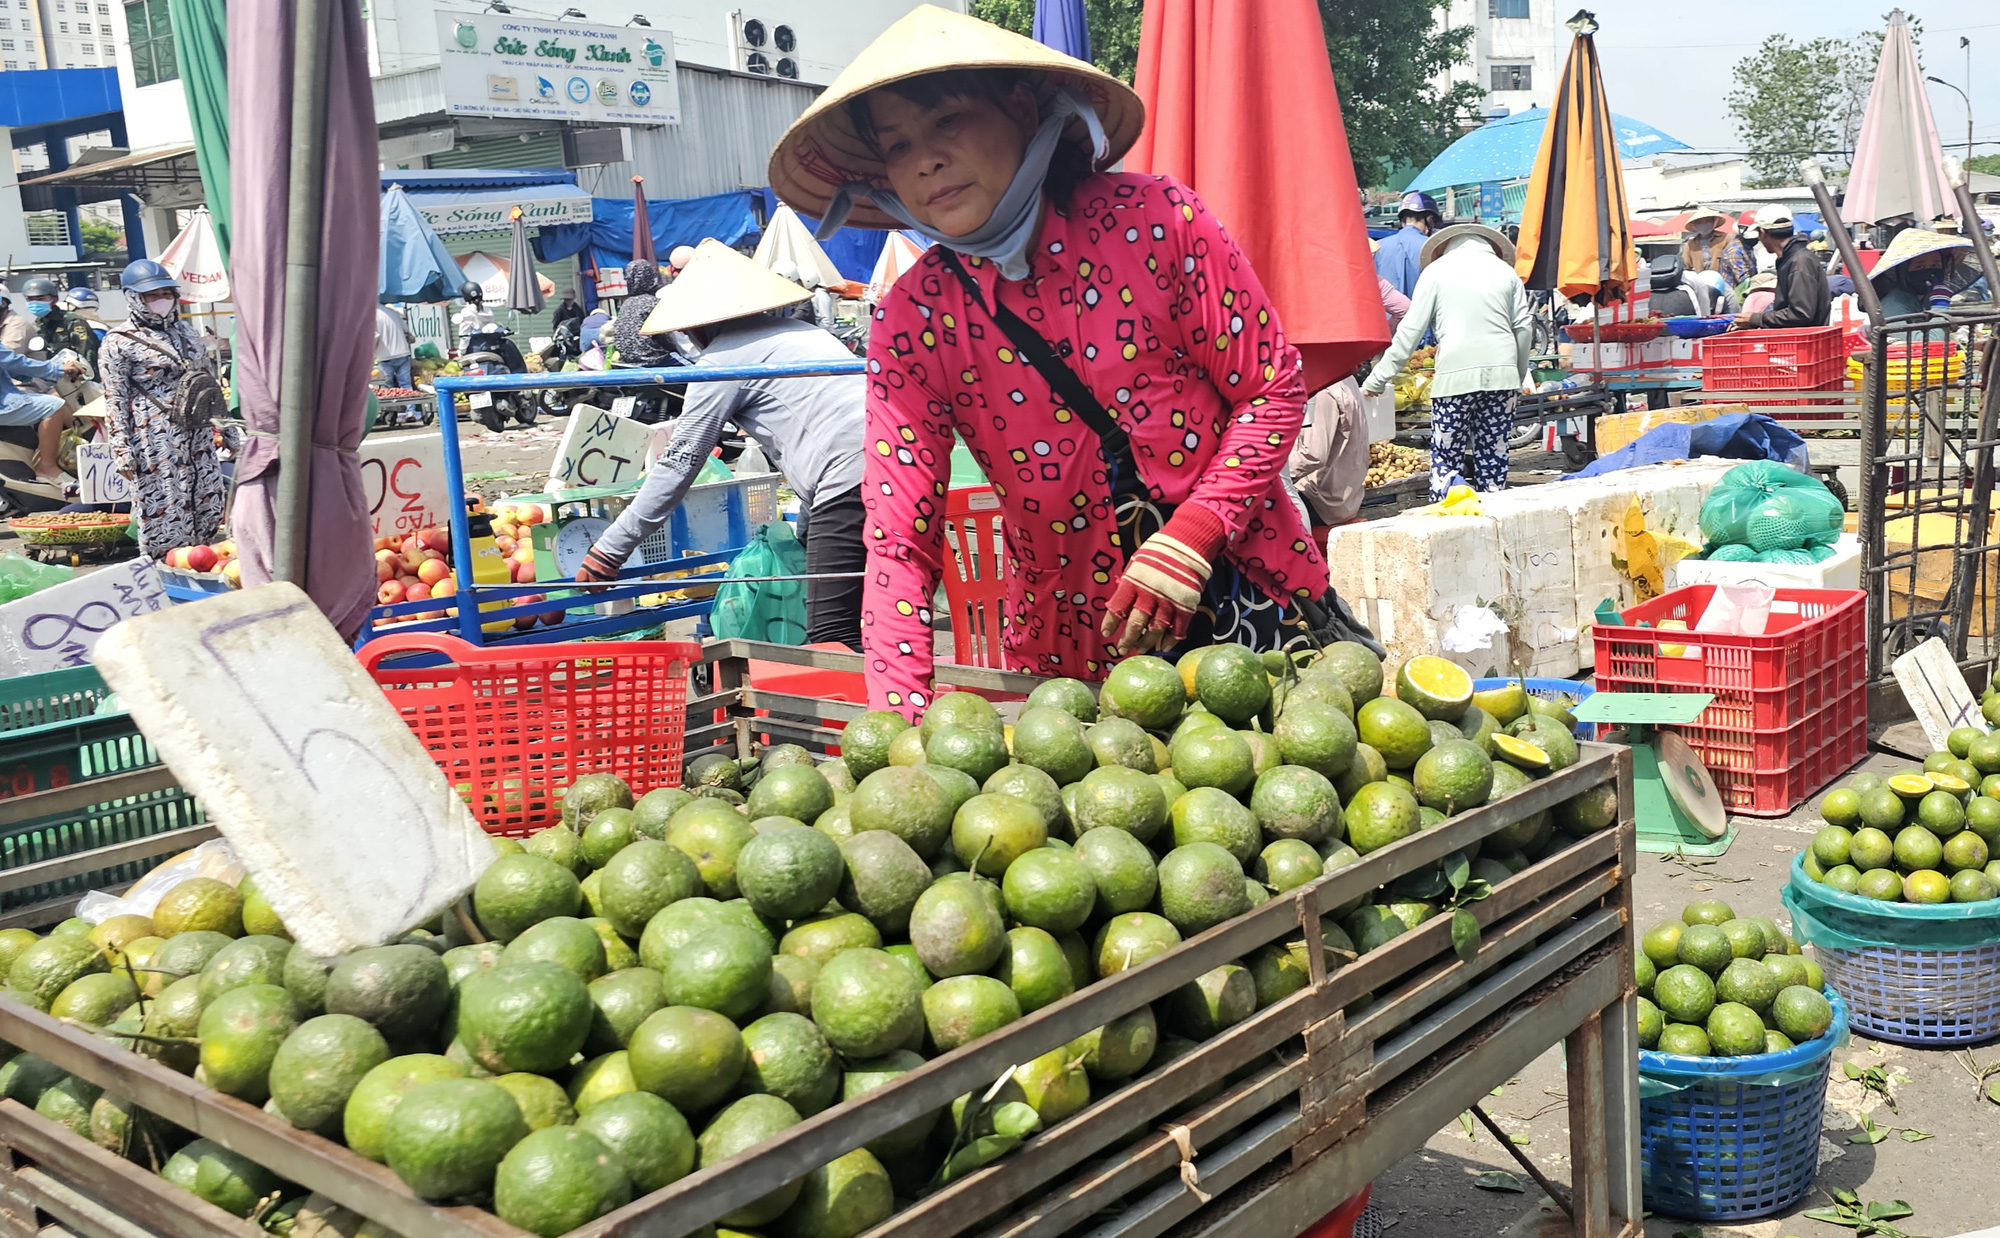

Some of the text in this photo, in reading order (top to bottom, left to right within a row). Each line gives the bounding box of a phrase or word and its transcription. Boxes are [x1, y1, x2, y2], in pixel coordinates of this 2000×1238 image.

[533, 26, 552, 35] TNHH
[600, 32, 618, 40] XANH
[493, 36, 528, 56] Sức
[534, 37, 577, 63] Sống
[585, 44, 632, 63] Xanh
[446, 206, 503, 223] Sống
[181, 269, 222, 285] VEDAN
[22, 600, 122, 651] 8
